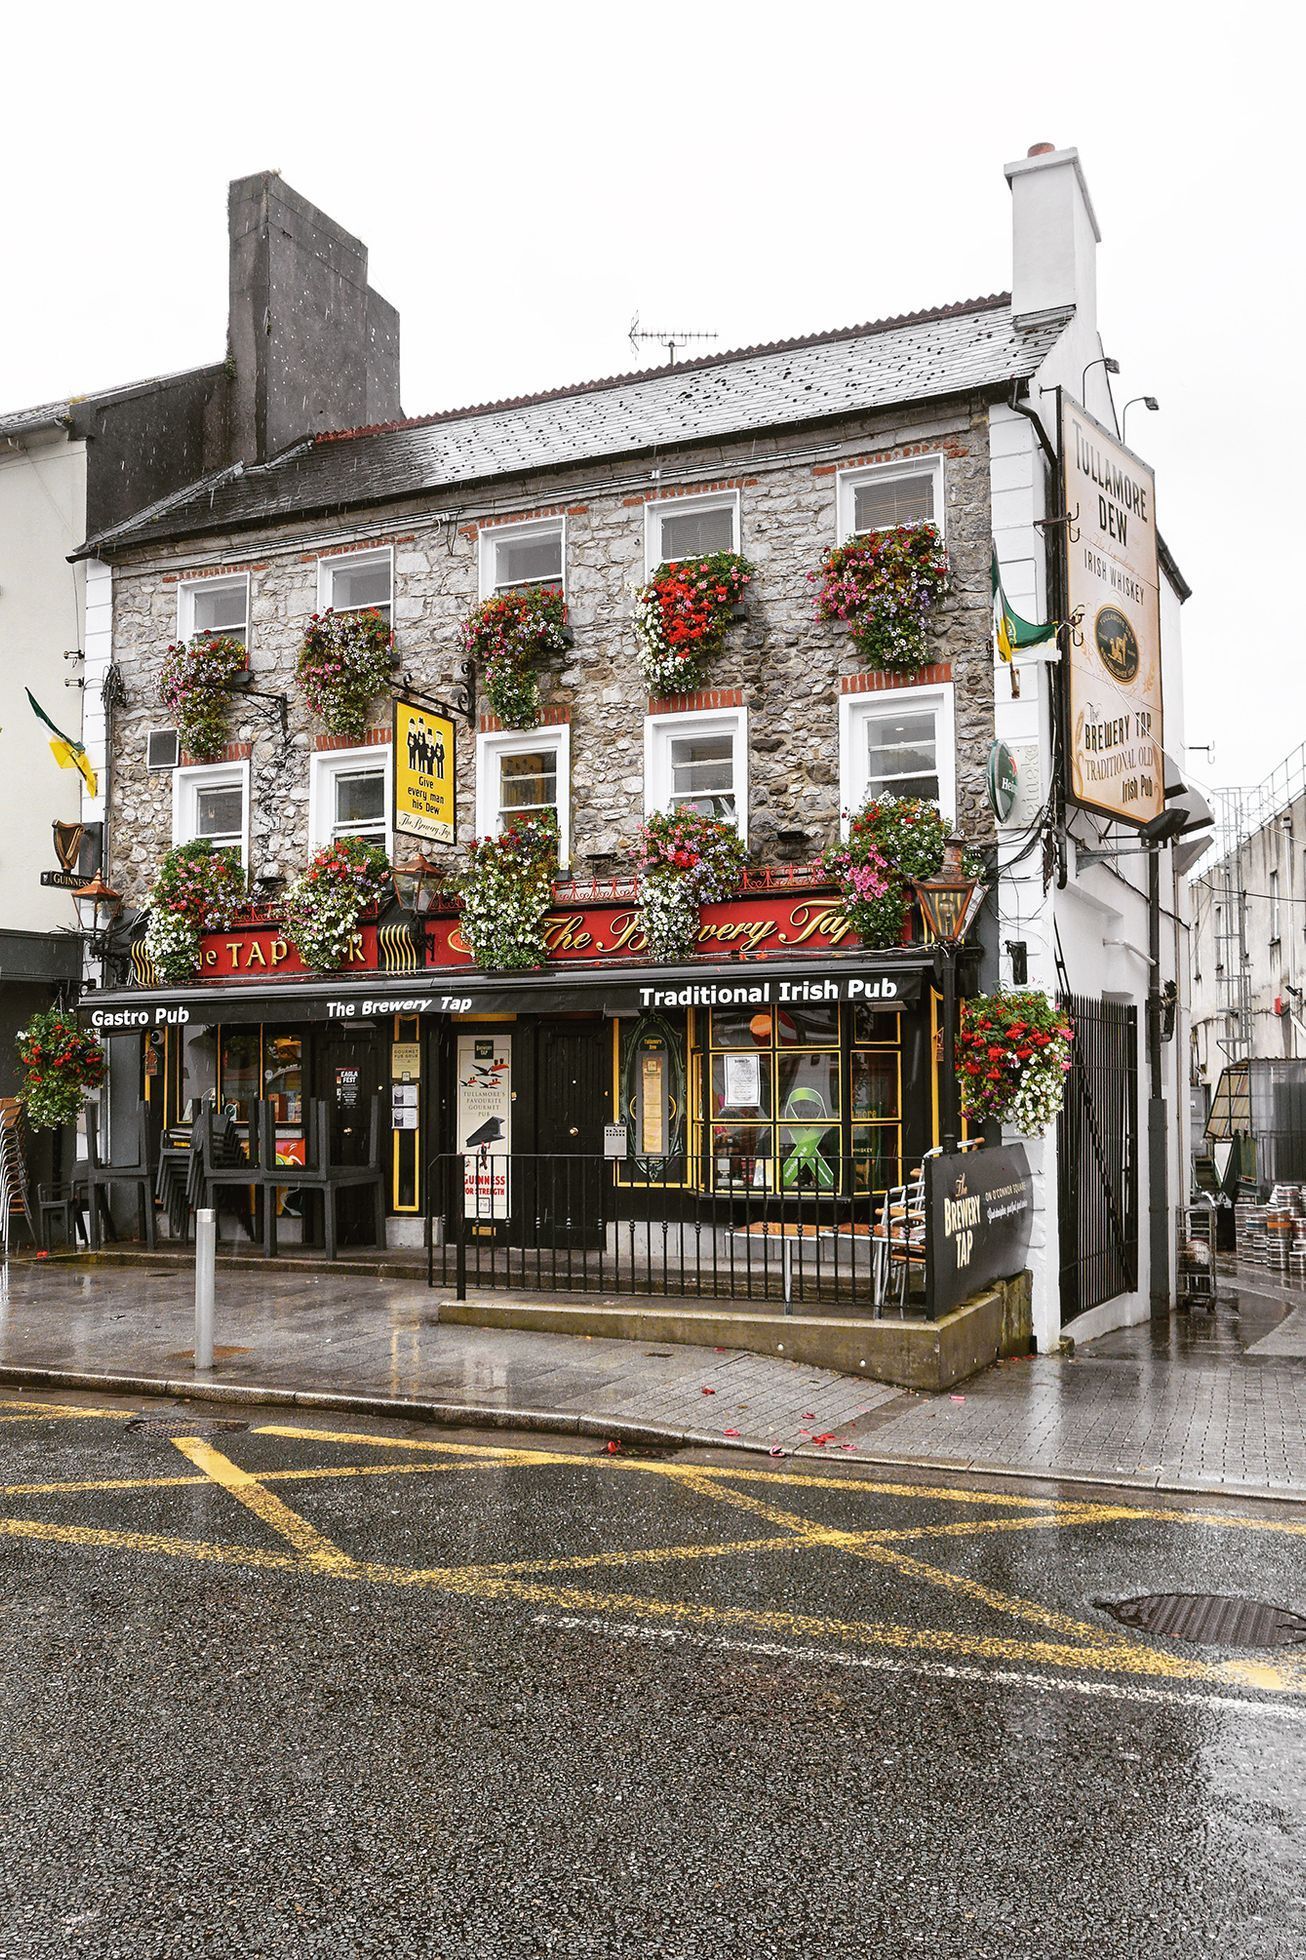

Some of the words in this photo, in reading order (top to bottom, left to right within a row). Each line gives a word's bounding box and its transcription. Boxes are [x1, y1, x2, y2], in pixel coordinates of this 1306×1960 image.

[1072, 418, 1148, 523] TULLAMORE
[1098, 494, 1127, 547] DEW
[1084, 548, 1107, 581] IRISH
[1110, 565, 1145, 606] WHISKEY
[1086, 701, 1103, 722] The
[1085, 715, 1130, 754] BREWERY
[1135, 712, 1152, 738] TAP
[1085, 748, 1136, 781] TRADITIONAL
[1138, 746, 1153, 767] OLD
[407, 786, 428, 802] every
[429, 792, 445, 805] man
[418, 776, 434, 789] Give
[1122, 776, 1138, 803] Irish
[1140, 774, 1153, 797] Pub
[411, 798, 423, 811] his
[425, 802, 440, 815] Dew
[53, 873, 91, 887] GUINNESS
[226, 941, 288, 968] TAP
[639, 982, 770, 1006] Traditional
[779, 979, 839, 1001] Irish
[847, 977, 898, 999] Pub
[91, 1010, 149, 1027] Gastro
[155, 1006, 190, 1024] Pub
[326, 1001, 355, 1018] The
[361, 998, 432, 1016] Brewery
[440, 996, 472, 1013] Tap
[463, 1175, 506, 1185] GUNNSS
[463, 1187, 474, 1195] OR
[944, 1195, 981, 1237] BREWERY
[955, 1230, 974, 1269] TAP
